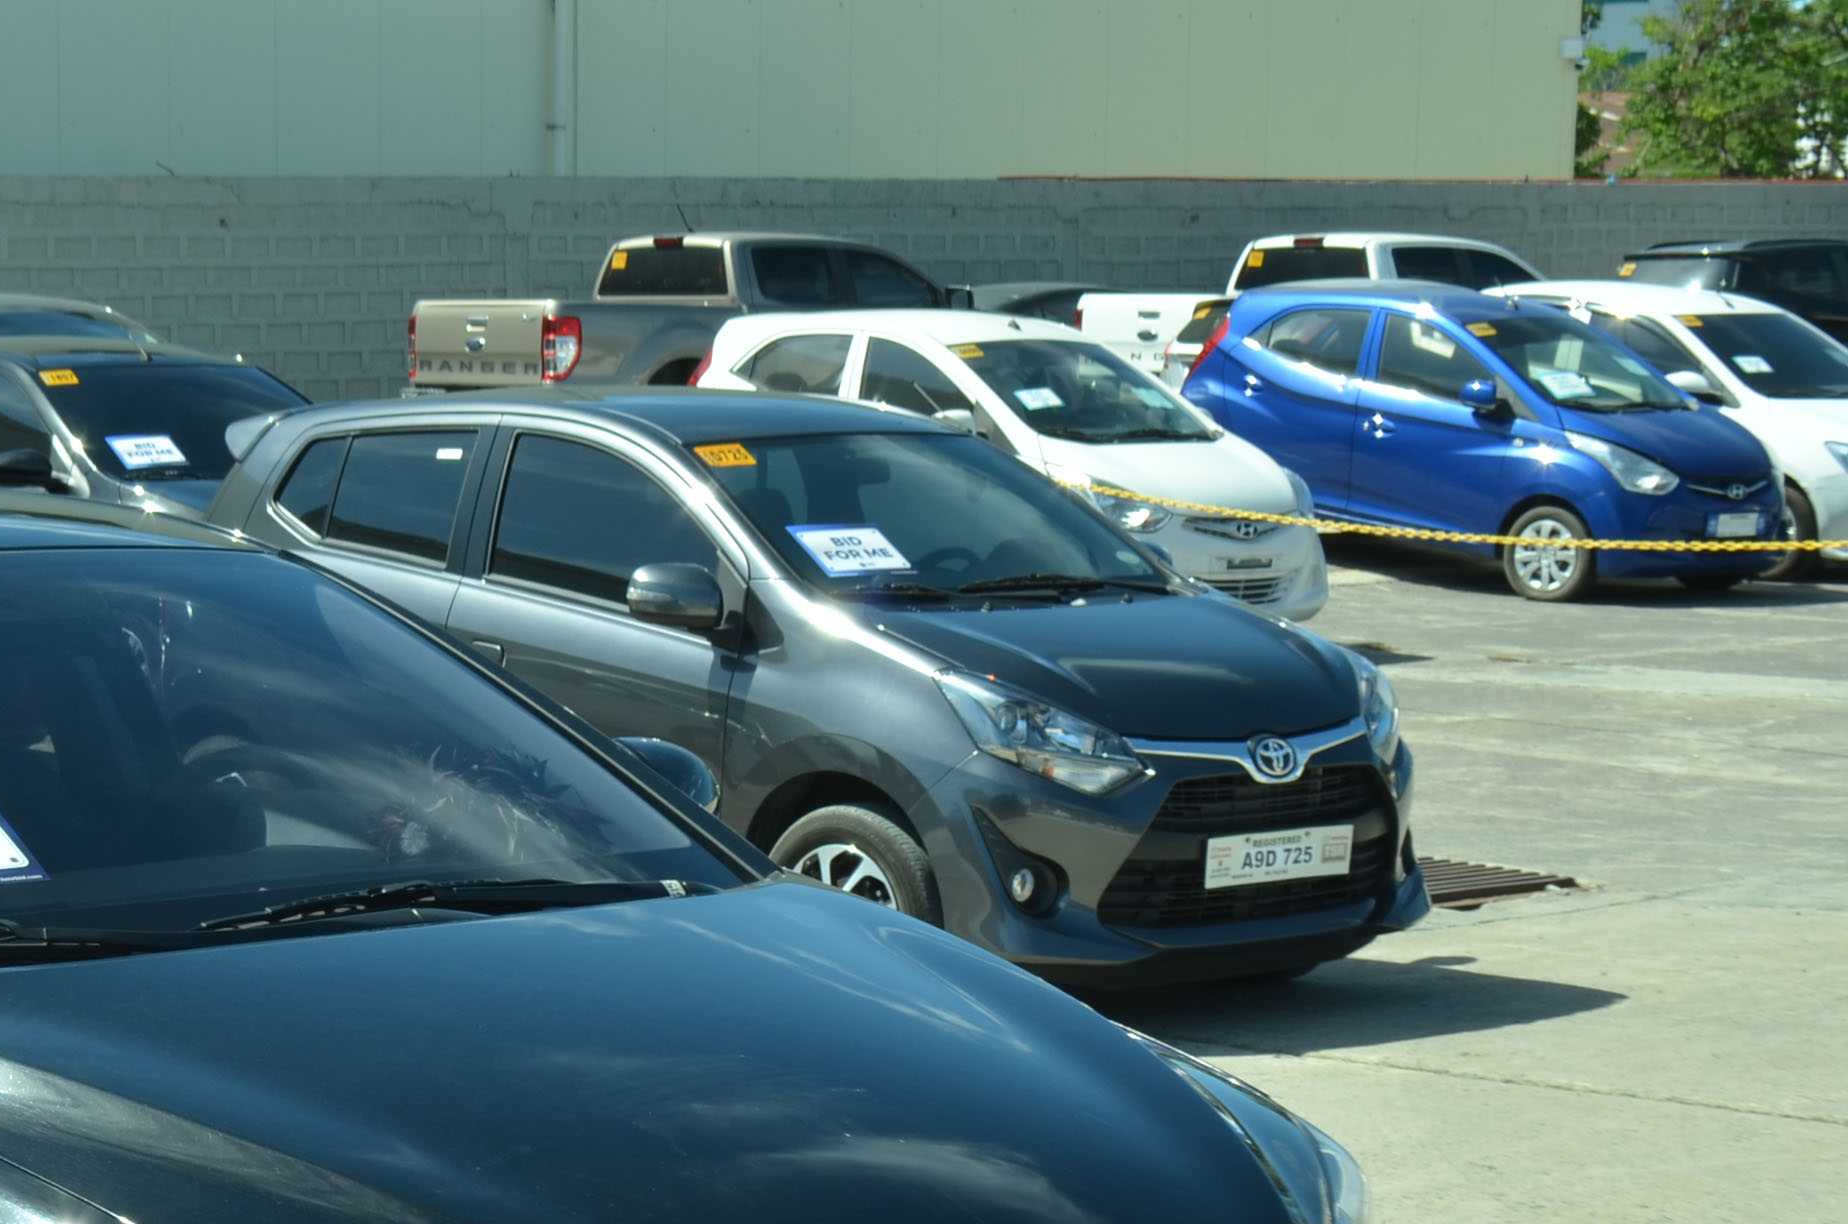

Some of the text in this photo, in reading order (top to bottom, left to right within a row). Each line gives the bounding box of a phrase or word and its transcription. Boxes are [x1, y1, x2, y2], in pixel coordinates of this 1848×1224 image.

[419, 360, 538, 375] RANGER
[830, 536, 862, 547] BID
[823, 548, 894, 560] FOR ME
[1242, 850, 1277, 870] A9D
[1283, 846, 1313, 865] 725
